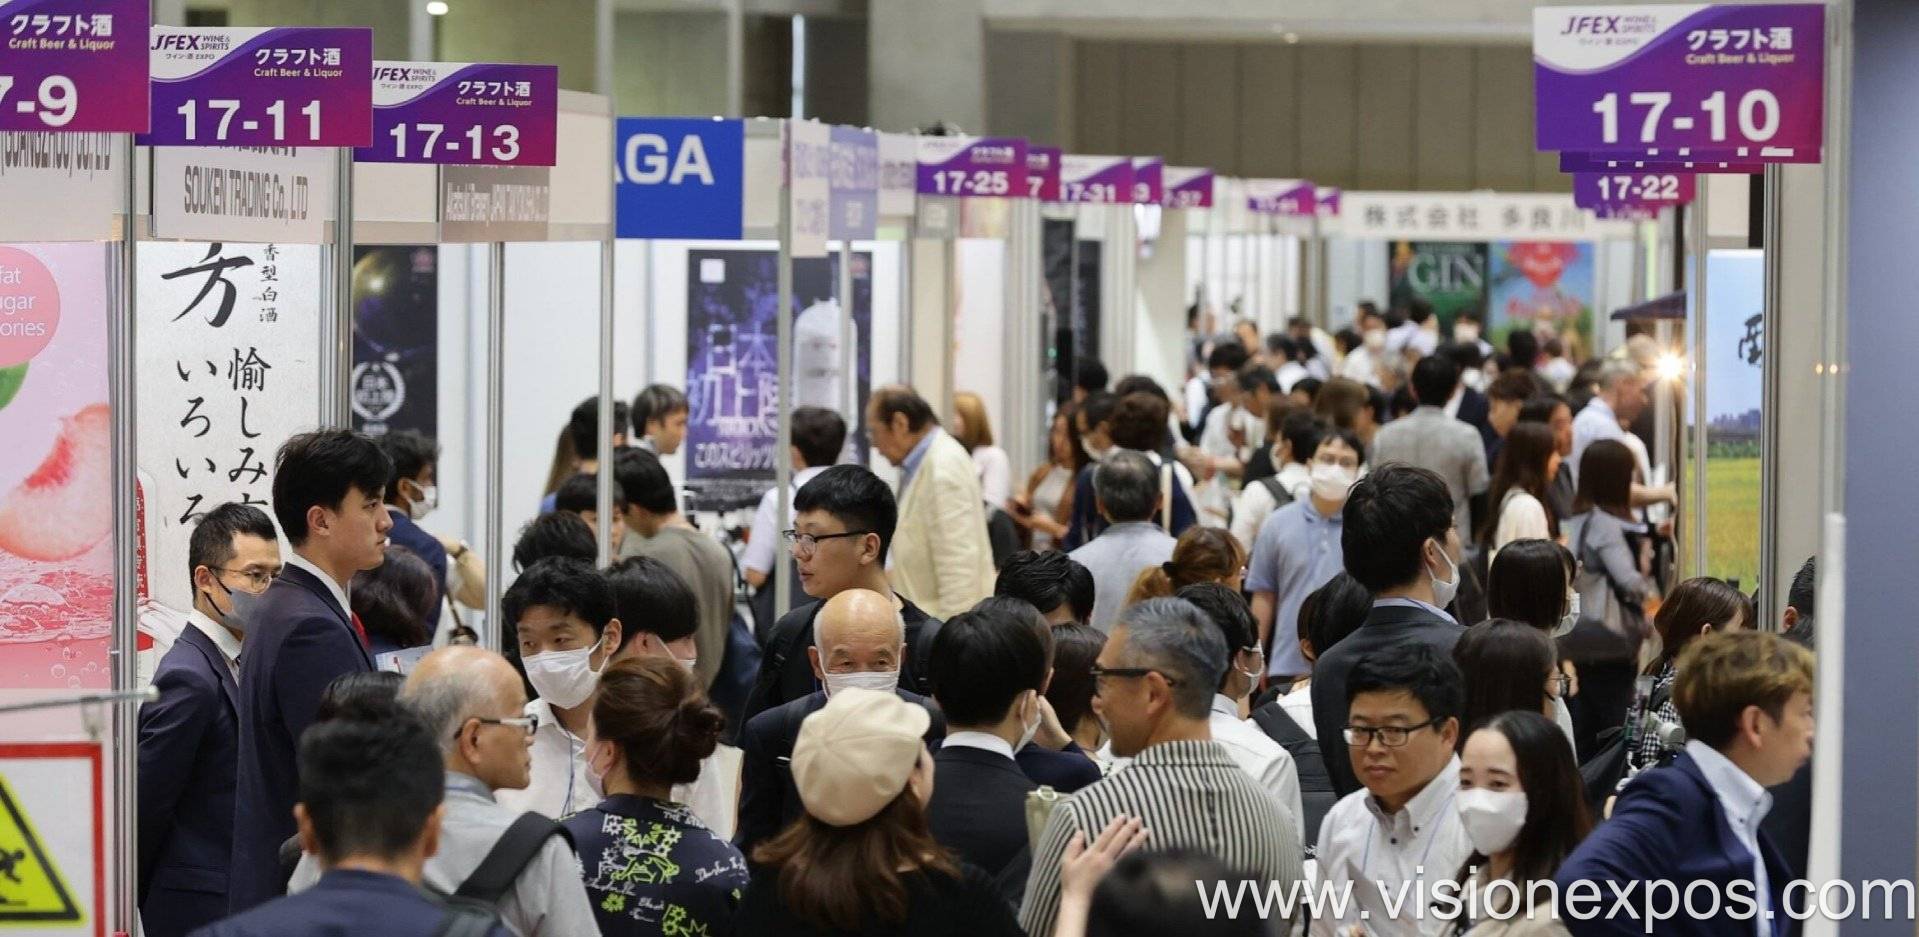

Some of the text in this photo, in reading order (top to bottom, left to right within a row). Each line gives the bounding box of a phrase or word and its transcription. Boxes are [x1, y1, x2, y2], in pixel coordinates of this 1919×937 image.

[10, 14, 113, 36] クラフト酒
[1560, 16, 1620, 35] JFEX
[9, 38, 115, 51] Craft Beer & Liquor
[151, 35, 200, 50] JFEX
[1687, 27, 1793, 50] クラフト酒
[255, 48, 341, 65] クラフト酒
[254, 68, 344, 79] Craft Beer & Liquor
[458, 81, 531, 97] クラフト酒
[456, 97, 532, 108] Craft Beer & Liquor
[177, 99, 321, 140] 17-11
[1592, 89, 1781, 143] 17-10
[389, 122, 521, 161] 17-13
[615, 133, 715, 185] GA
[184, 165, 228, 215] SOUKEN
[229, 169, 270, 218] TRADING
[290, 176, 308, 219] LTD
[932, 171, 1009, 193] 17-25
[1597, 175, 1680, 200] 17-22
[1408, 253, 1483, 294] GIN
